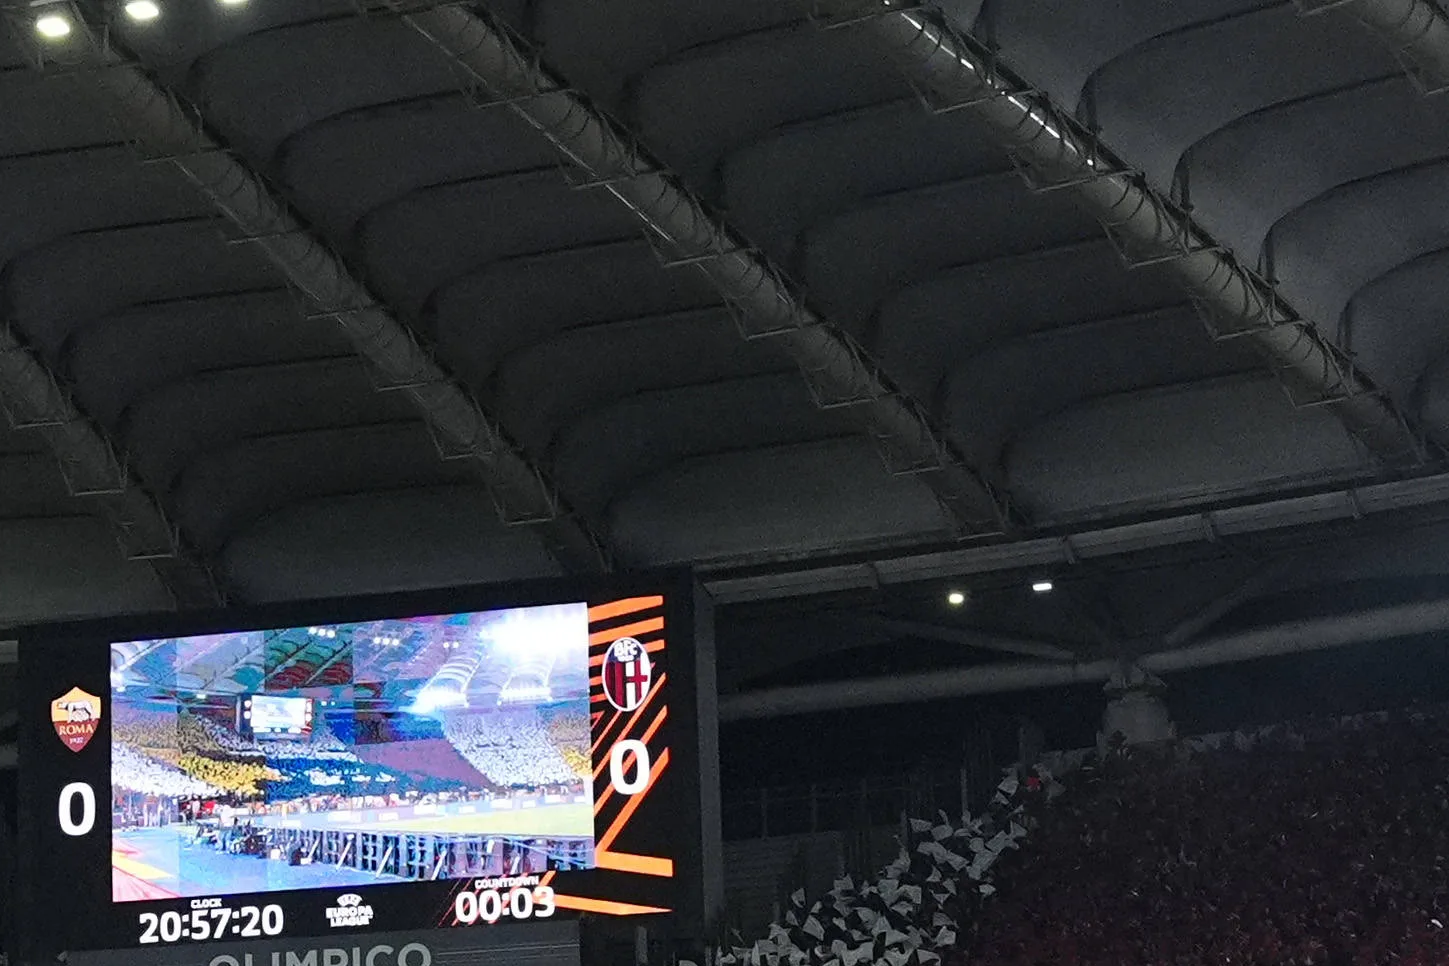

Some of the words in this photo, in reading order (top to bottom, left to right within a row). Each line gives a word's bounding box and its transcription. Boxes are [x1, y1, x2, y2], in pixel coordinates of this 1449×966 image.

[59, 724, 94, 736] ROMA
[610, 739, 650, 795] 0
[58, 782, 96, 836] 0
[474, 876, 539, 889] COUNTDOWN
[190, 898, 222, 909] CLOCK
[455, 886, 556, 923] 00:03
[325, 905, 374, 920] EUROPA
[138, 904, 284, 944] 20:57:20
[330, 916, 370, 928] LEAGUE
